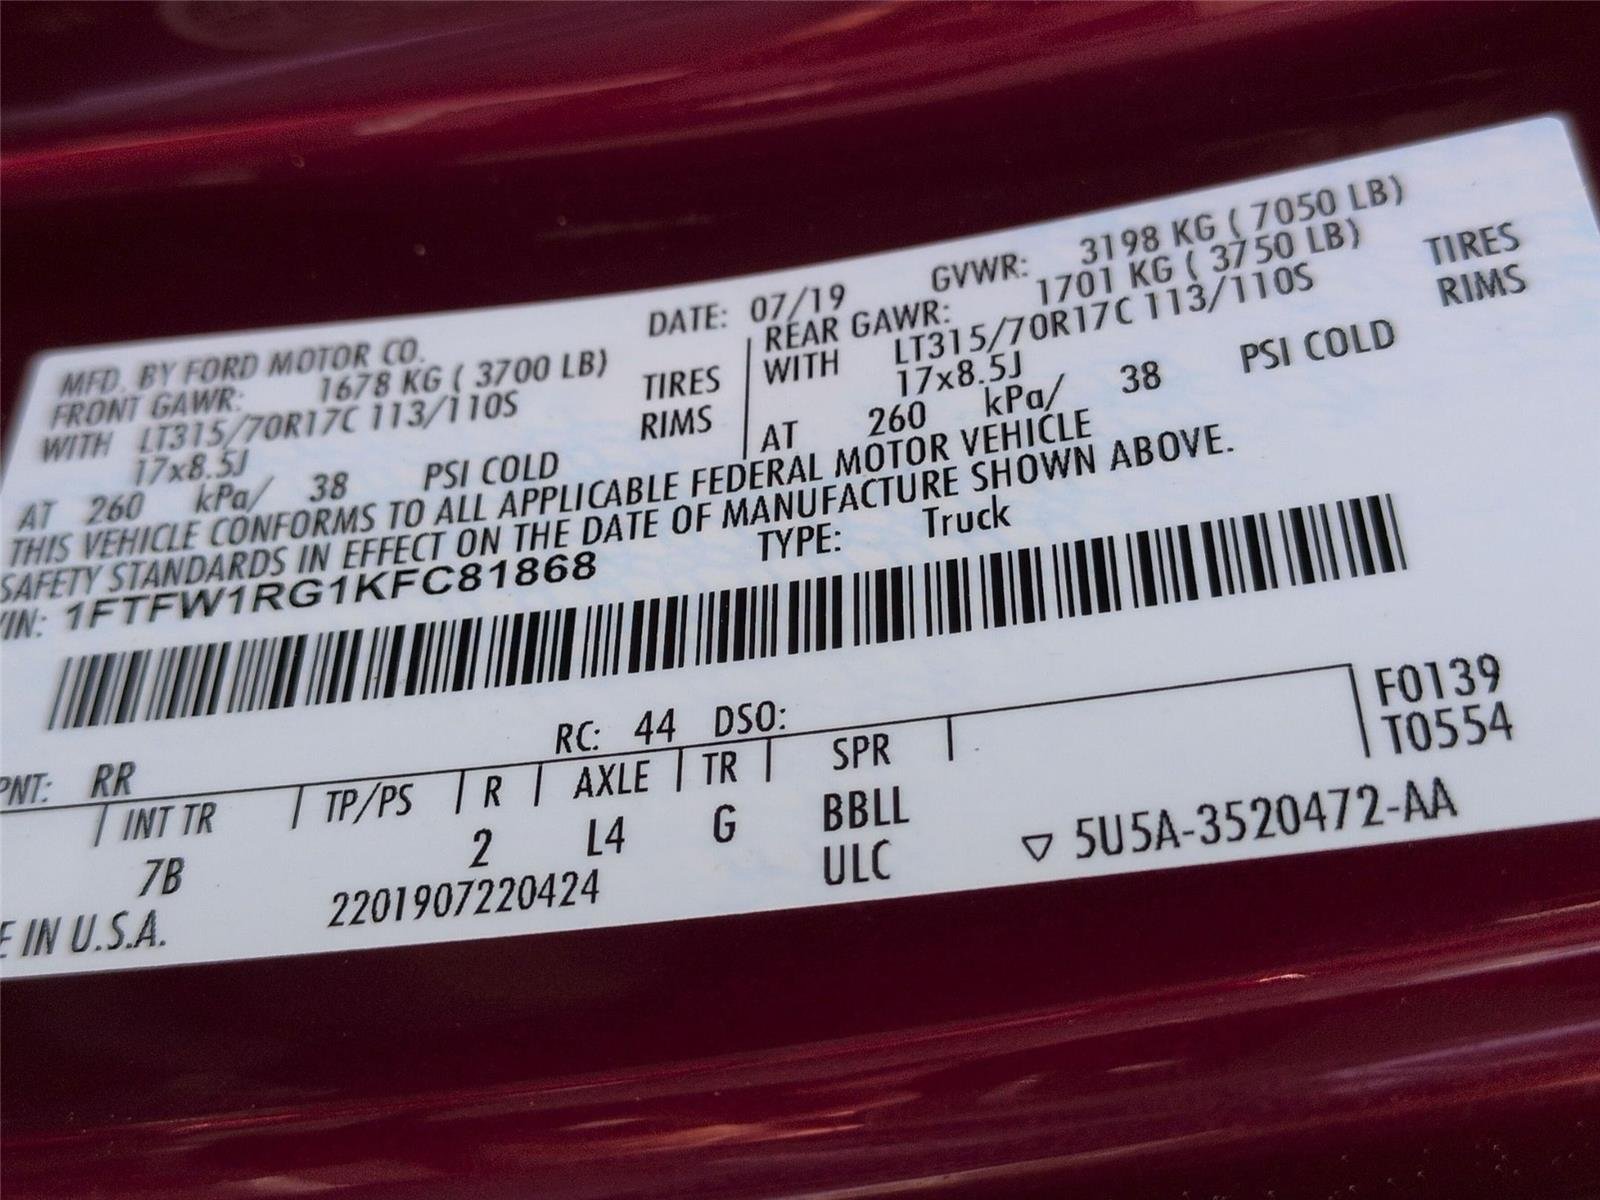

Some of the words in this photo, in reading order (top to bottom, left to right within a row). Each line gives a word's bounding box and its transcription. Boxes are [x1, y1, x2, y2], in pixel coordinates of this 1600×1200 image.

[931, 252, 1028, 292] GVWR:
[1079, 224, 1160, 265] 3198
[1172, 213, 1216, 247] KG
[1250, 188, 1336, 231] 7050
[1348, 175, 1403, 211] LB)
[648, 303, 728, 337] DATE:
[750, 282, 846, 324] 07/19
[763, 349, 839, 385] WITH
[894, 296, 1133, 365] LT315/70R17C
[1144, 262, 1314, 320] 113/110S
[1422, 221, 1520, 266] TIRES
[765, 317, 839, 353] REAR
[851, 299, 950, 338] GAWR:
[1037, 268, 1112, 306] 1701
[1129, 256, 1173, 289] KG
[1209, 231, 1294, 273] 3750
[1306, 218, 1360, 253] LB)
[897, 351, 1023, 398] 17x8.5J
[1436, 263, 1527, 307] RIMS
[51, 396, 138, 429] FRONT
[150, 387, 244, 419] GAWR:
[319, 370, 392, 404] 1678
[402, 366, 441, 394] KG
[475, 355, 551, 388] 3700
[562, 347, 608, 378] LB)
[60, 366, 125, 397] MFD.
[138, 364, 181, 390] BY
[184, 353, 258, 385] FORD
[267, 342, 370, 378] MOTOR
[383, 338, 425, 366] CO.
[760, 420, 799, 453] AT
[868, 401, 926, 437] 260
[984, 373, 1066, 418] kPa/
[1119, 360, 1163, 394] 38
[1239, 337, 1291, 374] PSI
[1303, 319, 1396, 361] COLD
[41, 431, 113, 463] WITH
[140, 405, 360, 453] LT315/70R17C
[372, 390, 519, 430] 113/110S
[643, 365, 721, 401] TIRES
[134, 449, 250, 487] 17x8.5J
[640, 405, 713, 441] RIMS
[0, 566, 101, 603] SAFETY
[109, 546, 288, 594] STANDARDS
[299, 543, 331, 574] IN
[343, 532, 446, 570] EFFECT
[456, 525, 502, 557] ON
[514, 518, 570, 553] THE
[582, 508, 658, 546] DATE
[671, 503, 712, 535] OF
[722, 466, 959, 529] MANUFACTURE
[971, 444, 1095, 492] SHOWN
[1109, 423, 1235, 471] ABOVE.
[10, 533, 73, 567] THIS
[83, 520, 200, 560] VEHICLE
[210, 502, 377, 547] CONFORMS
[389, 499, 425, 529] TO
[433, 490, 487, 527] ALL
[499, 471, 679, 520] APPLICABLE
[690, 452, 823, 499] FEDERAL
[835, 432, 950, 479] MOTOR
[961, 408, 1092, 457] VEHICLE
[17, 499, 58, 531] AT
[86, 492, 146, 526] 260
[195, 475, 275, 515] kPa/
[309, 471, 349, 502] 38
[423, 460, 470, 492] PSI
[482, 451, 560, 486] COLD
[758, 523, 841, 561] TYPE:
[922, 494, 1011, 538] Truck
[65, 550, 597, 631] 1FTFW1RG1KFC81868
[555, 720, 601, 755] RC:
[634, 707, 676, 745] 44
[832, 733, 892, 770] SPR
[90, 761, 136, 799] RR
[484, 775, 503, 809] R
[573, 760, 650, 800] AXLE
[702, 750, 738, 785] TR
[122, 805, 176, 841] INT
[182, 801, 217, 836] TR
[325, 782, 413, 824] TP/PS
[713, 803, 736, 843] G
[823, 785, 910, 832] BBLL
[1075, 777, 1459, 859] 5U5A-3520472-AA
[469, 828, 493, 868] 2
[587, 816, 626, 857] L4
[823, 838, 891, 885] ULC
[138, 857, 185, 897] 7B
[327, 869, 600, 928] 2201907220424
[21, 916, 62, 957] IN
[70, 909, 167, 952] U.S.A.
